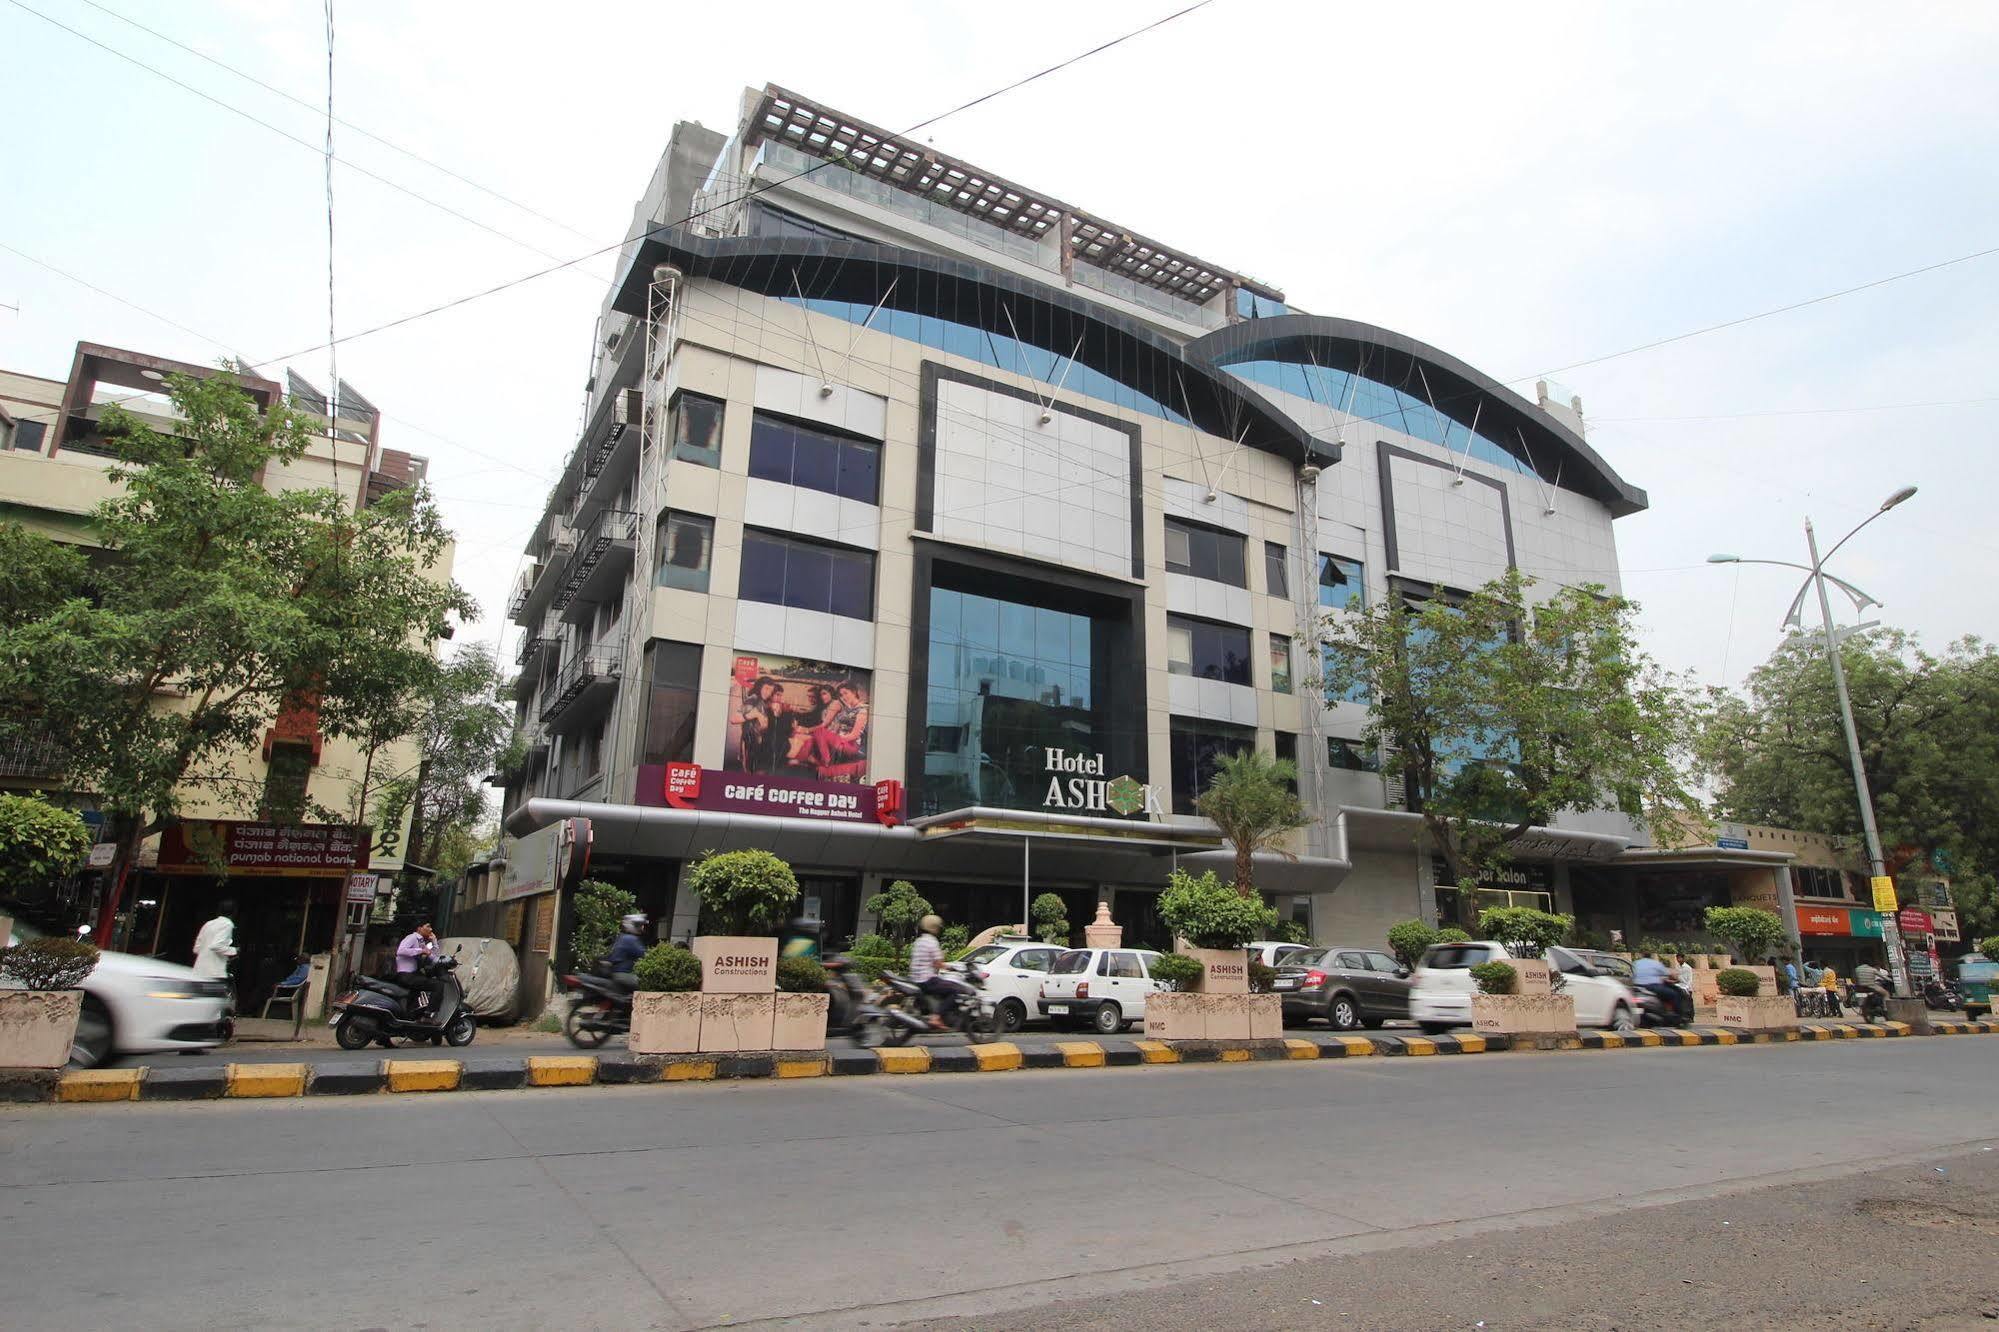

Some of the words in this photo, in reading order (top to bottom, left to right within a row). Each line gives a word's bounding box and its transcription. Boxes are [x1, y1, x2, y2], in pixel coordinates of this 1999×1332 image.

[1045, 747, 1104, 776] Hotel
[230, 852, 272, 864] punjab
[275, 853, 321, 863] national
[714, 956, 769, 967] ASHISH
[714, 967, 768, 976] Constructions
[1210, 965, 1243, 974] ASHISH
[1723, 1015, 1742, 1023] NMC
[1149, 1021, 1166, 1031] NMC
